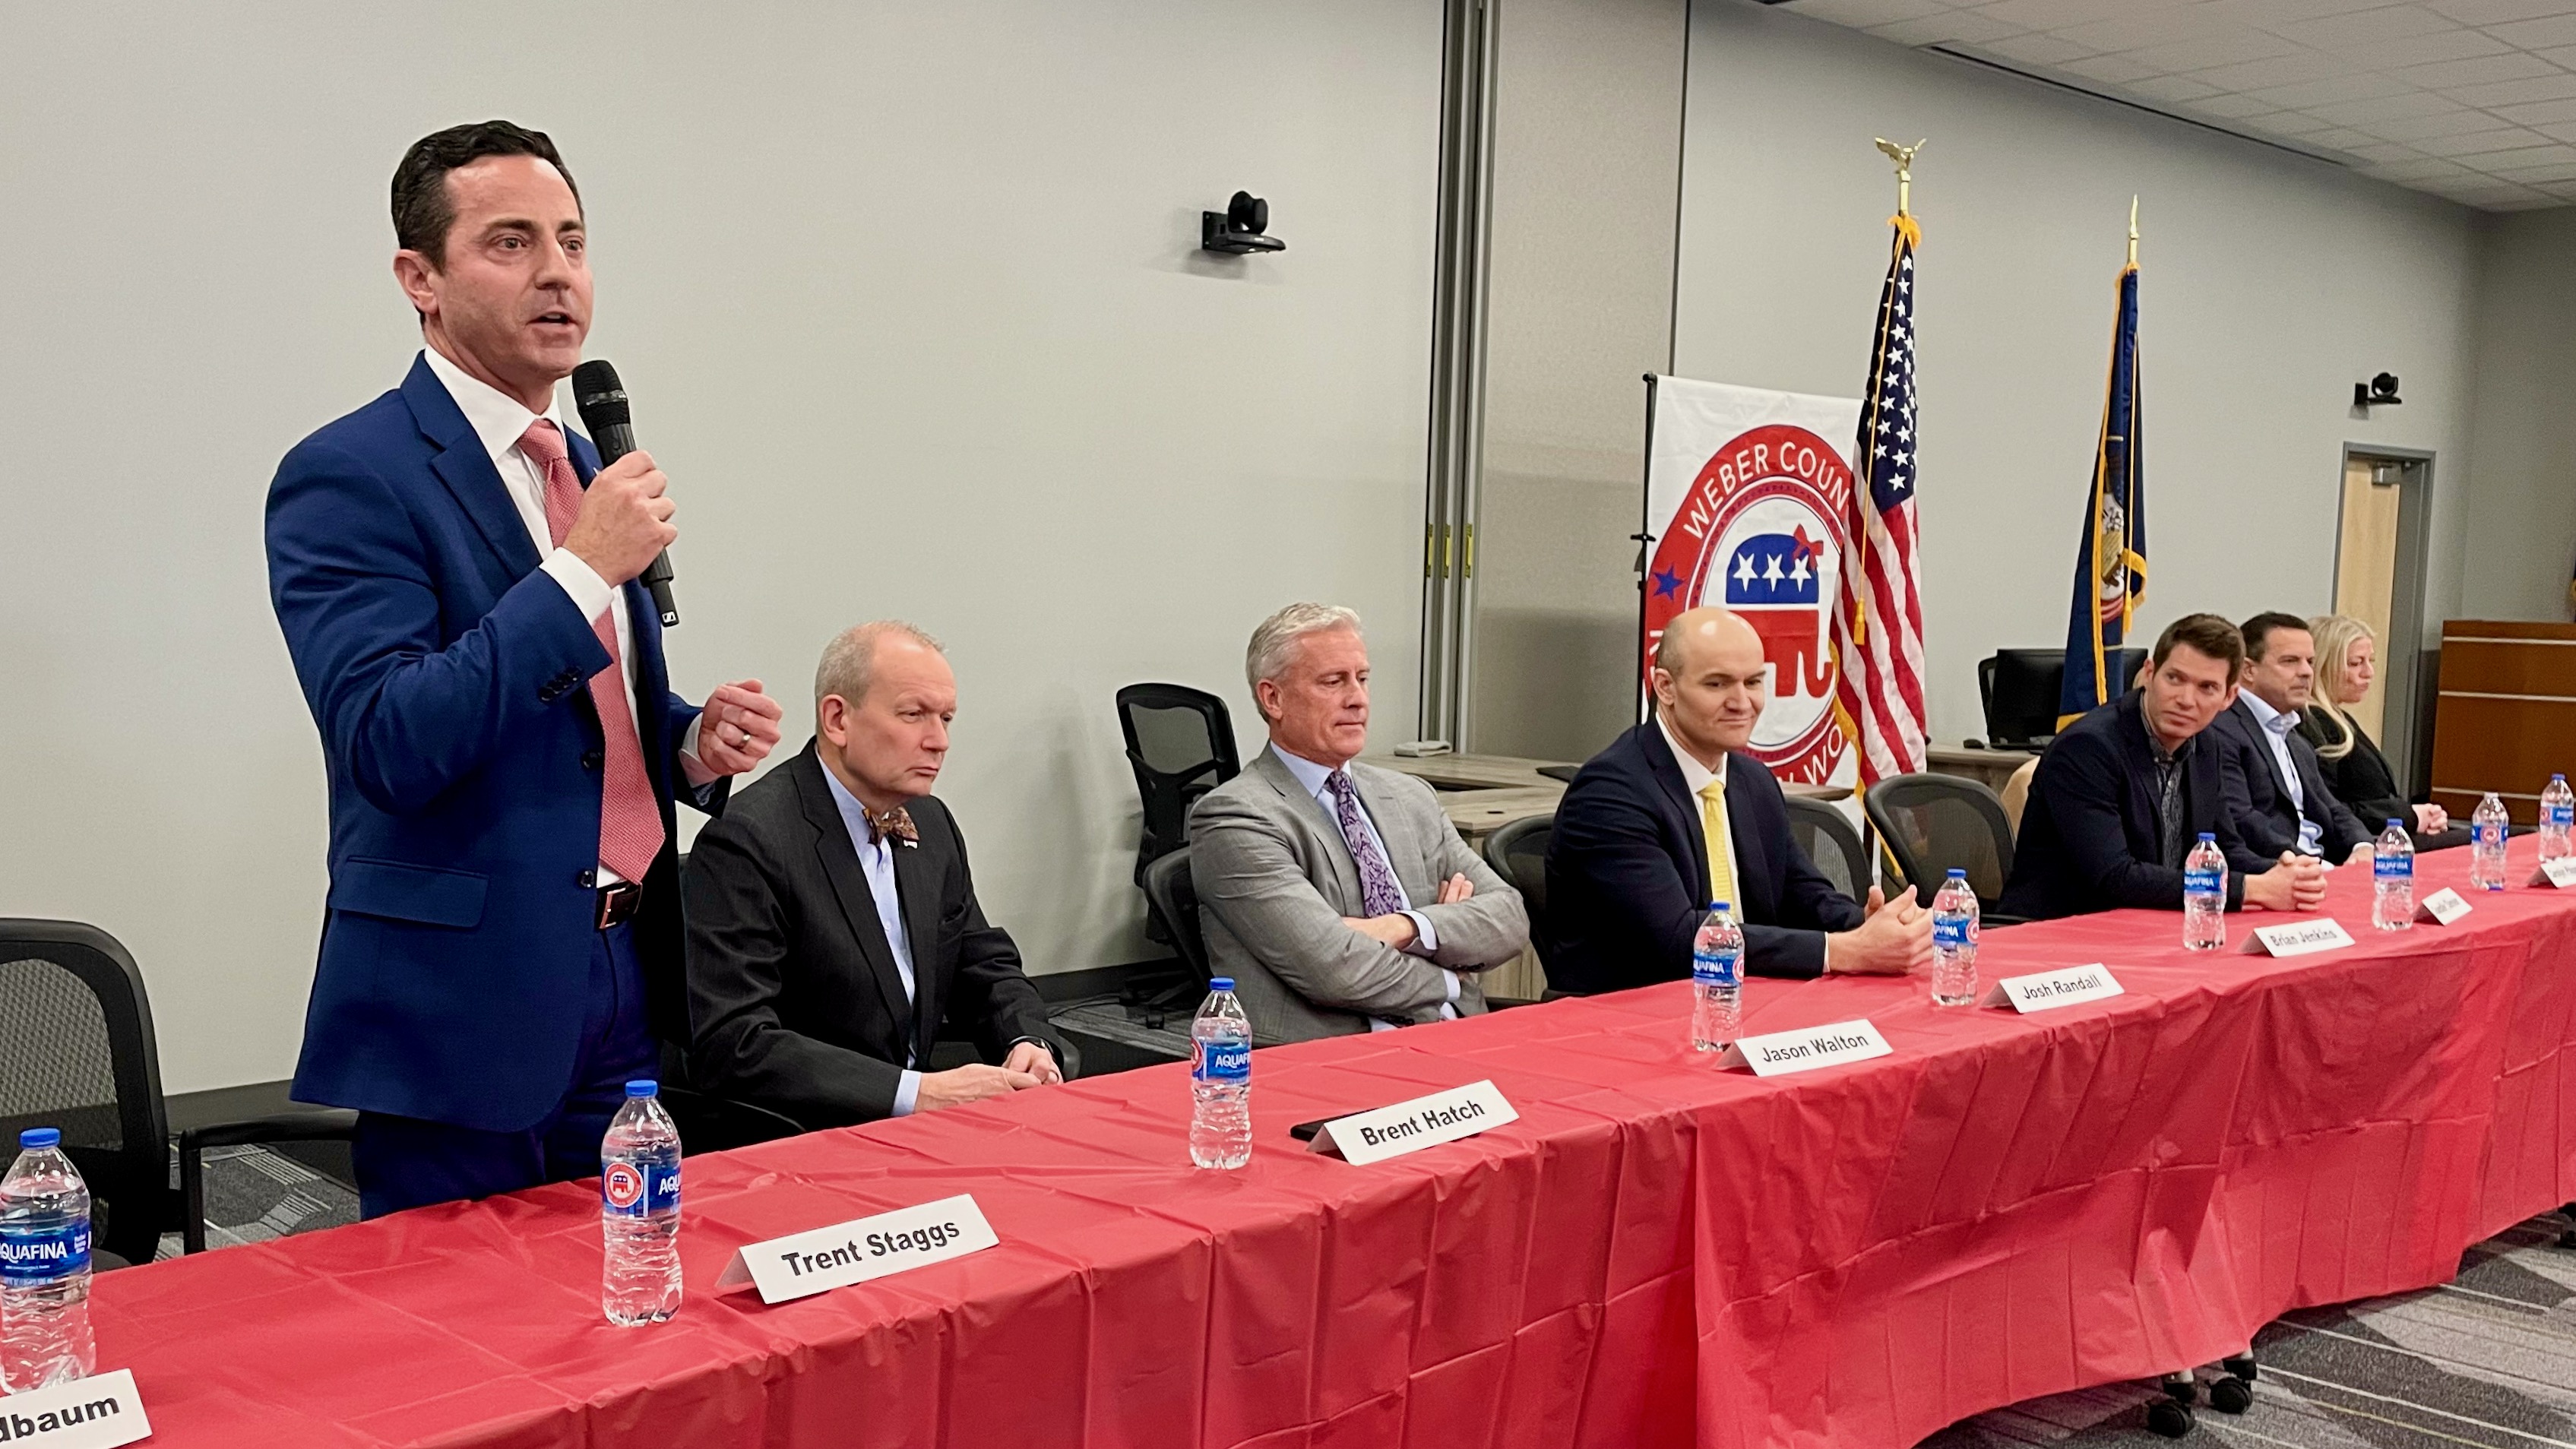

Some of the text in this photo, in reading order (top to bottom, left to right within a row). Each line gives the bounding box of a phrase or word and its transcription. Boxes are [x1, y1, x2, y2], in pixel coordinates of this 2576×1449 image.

[1683, 441, 1850, 539] WEBER COUN
[2269, 929, 2337, 946] Brian Jenkins
[2023, 973, 2103, 999] Josh Randall
[1761, 1035, 1869, 1062] Jason Walton
[1359, 1099, 1486, 1147] Brent Hatch
[0, 1241, 68, 1264] QUAFINA
[780, 1222, 960, 1277] Trent Staggs
